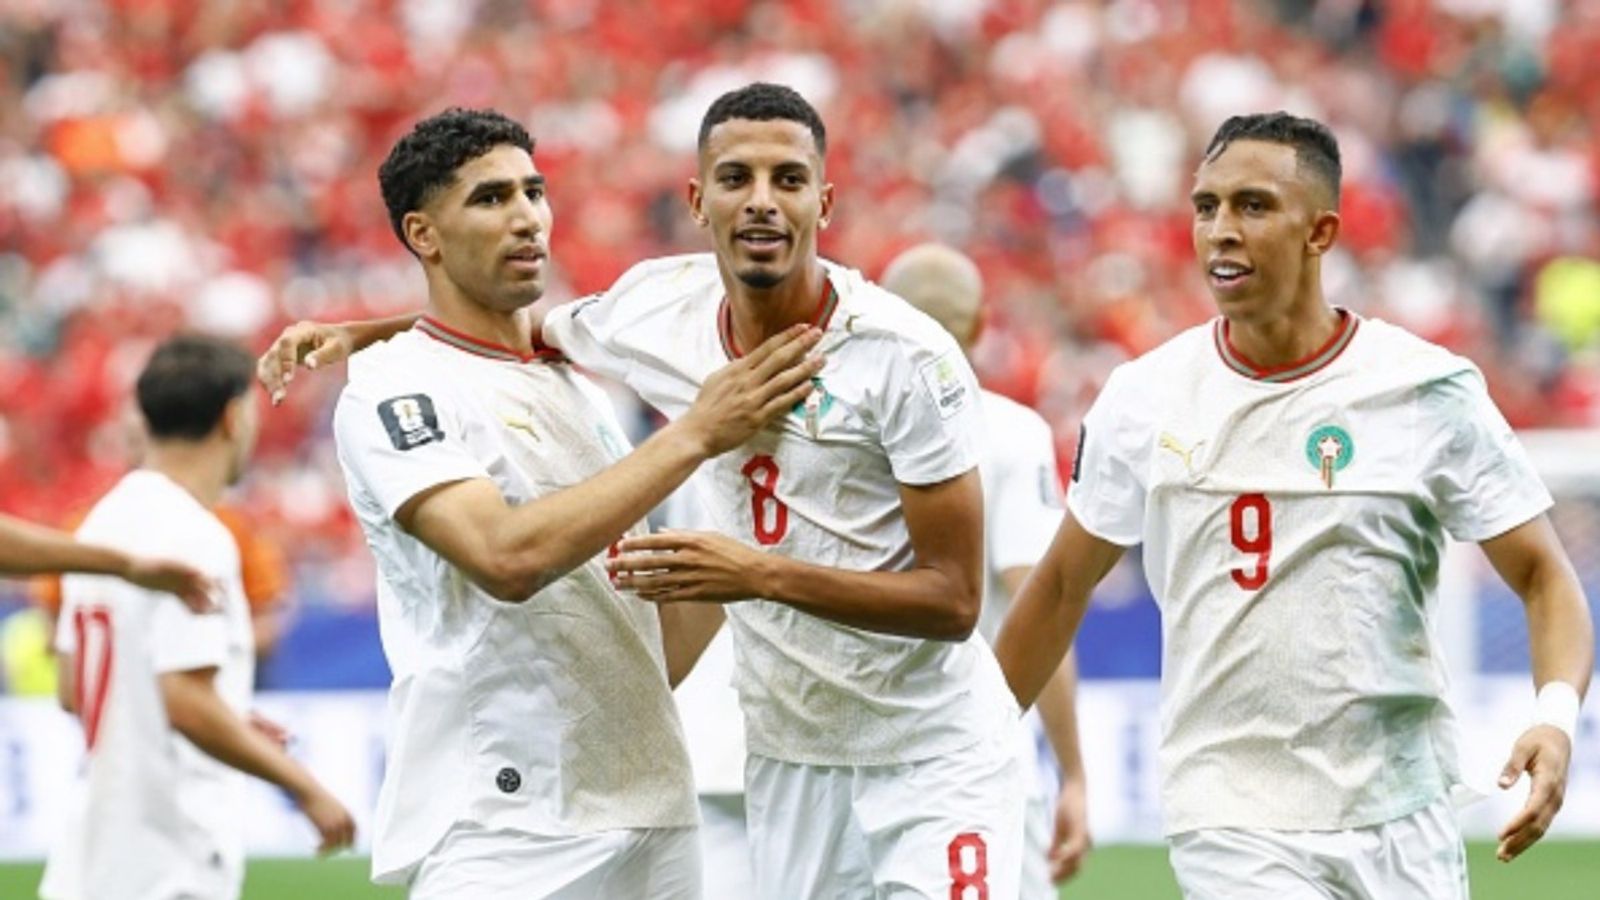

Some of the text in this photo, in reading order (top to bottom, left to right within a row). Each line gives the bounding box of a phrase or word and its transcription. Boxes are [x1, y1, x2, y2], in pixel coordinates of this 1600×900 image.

[741, 454, 789, 546] 8
[1228, 491, 1274, 592] 9
[947, 832, 989, 900] 8
